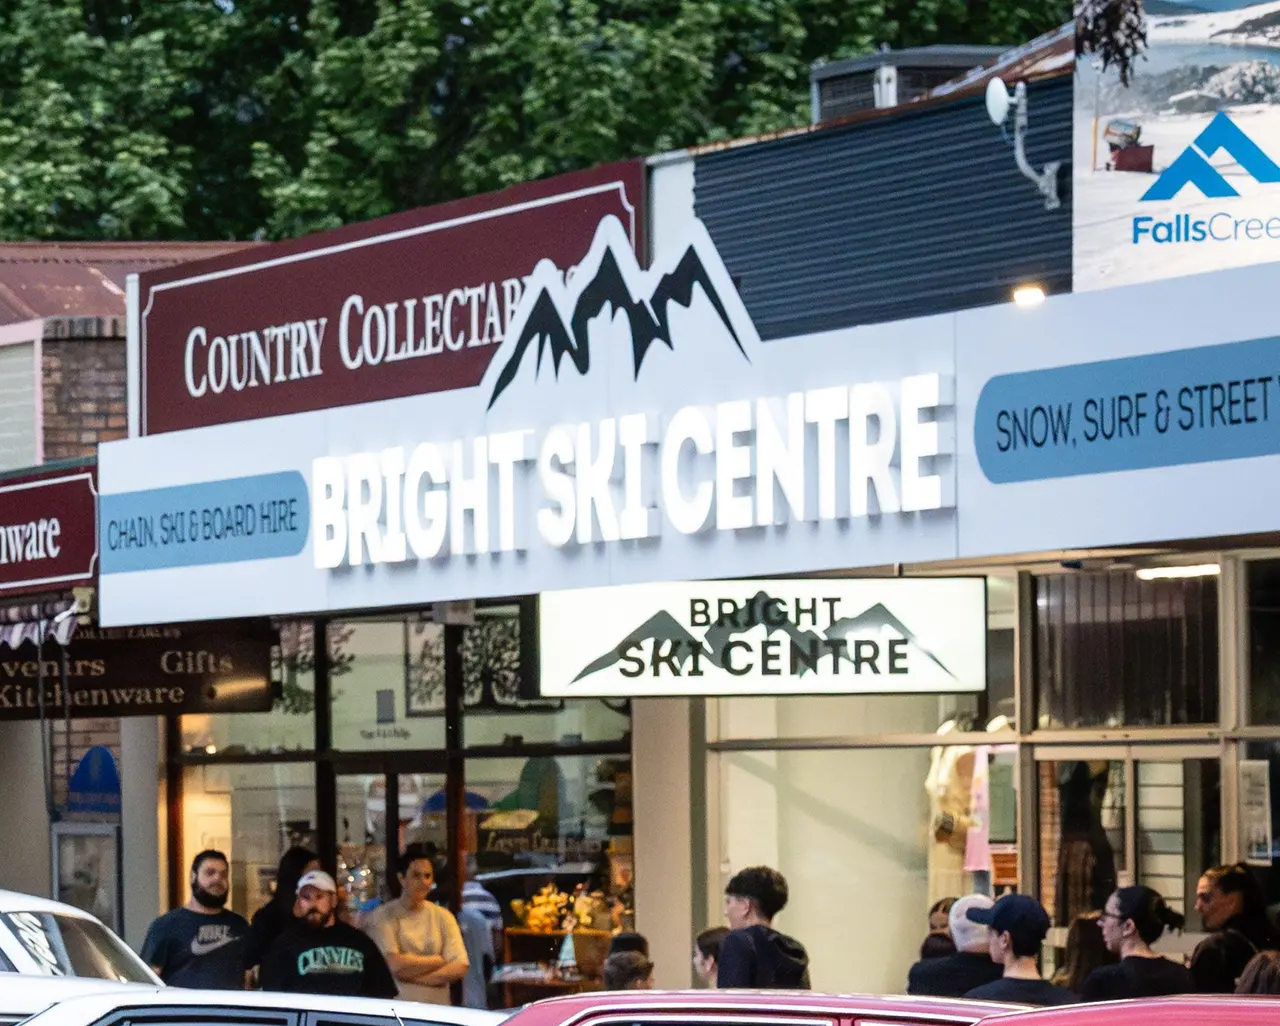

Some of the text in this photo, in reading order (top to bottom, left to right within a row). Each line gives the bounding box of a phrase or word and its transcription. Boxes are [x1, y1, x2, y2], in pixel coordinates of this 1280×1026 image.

[339, 266, 576, 370] COLLECTAB
[996, 376, 1273, 452] SNOW, SURF & STREET
[312, 373, 946, 569] BRIGHT SKI CENTRE
[107, 498, 298, 551] CHAIN, SKI & BOARD HIRE
[690, 597, 842, 628] BRIGHT
[159, 650, 235, 675] Gifts
[618, 637, 909, 678] SKI CENTRE
